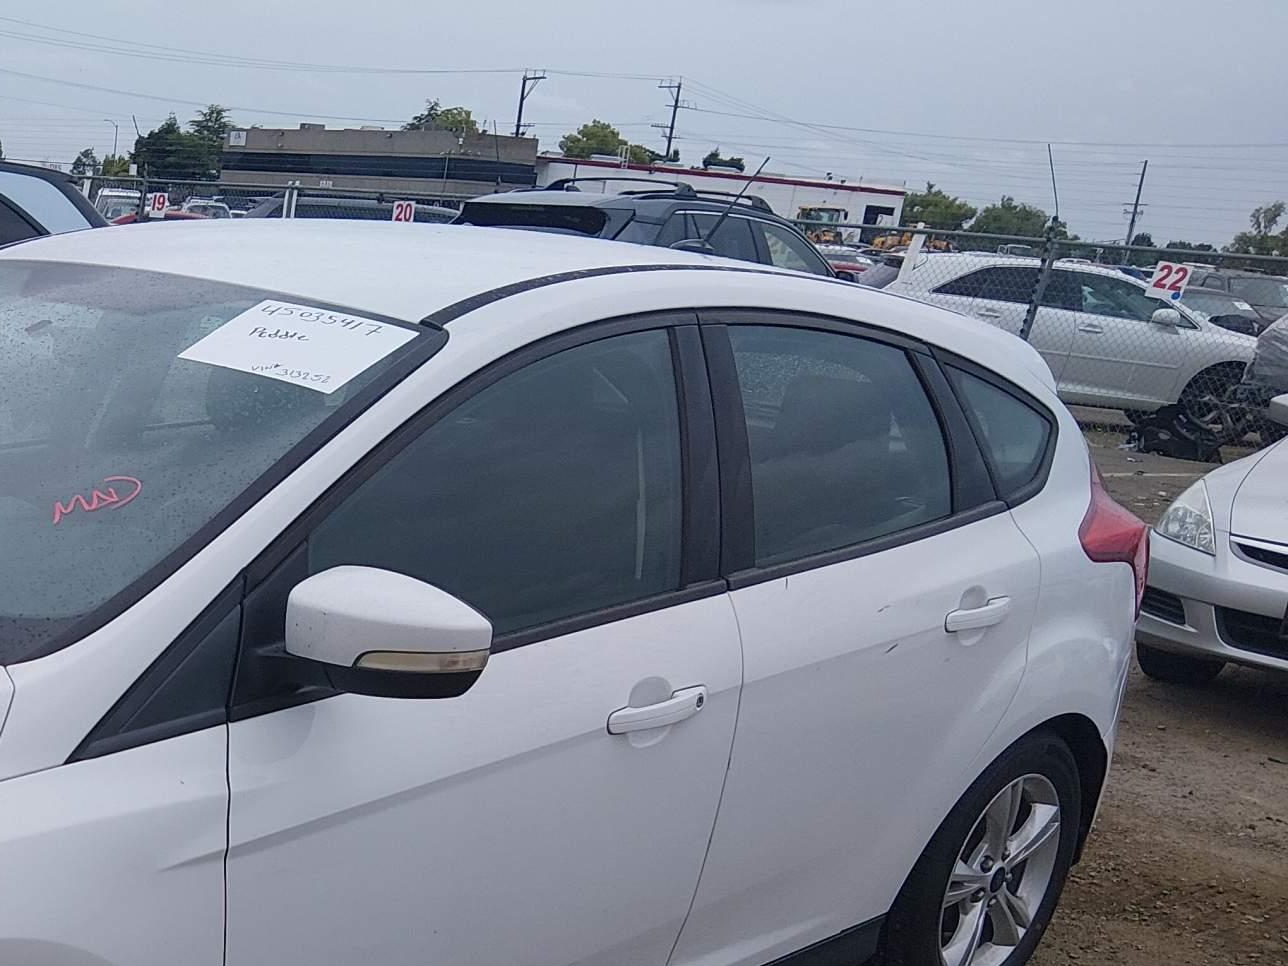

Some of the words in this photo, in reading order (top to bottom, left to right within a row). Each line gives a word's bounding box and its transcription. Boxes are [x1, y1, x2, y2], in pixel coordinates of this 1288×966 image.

[152, 194, 166, 211] 19
[395, 203, 412, 221] 20
[1153, 264, 1188, 291] 22
[261, 305, 383, 336] 45035417
